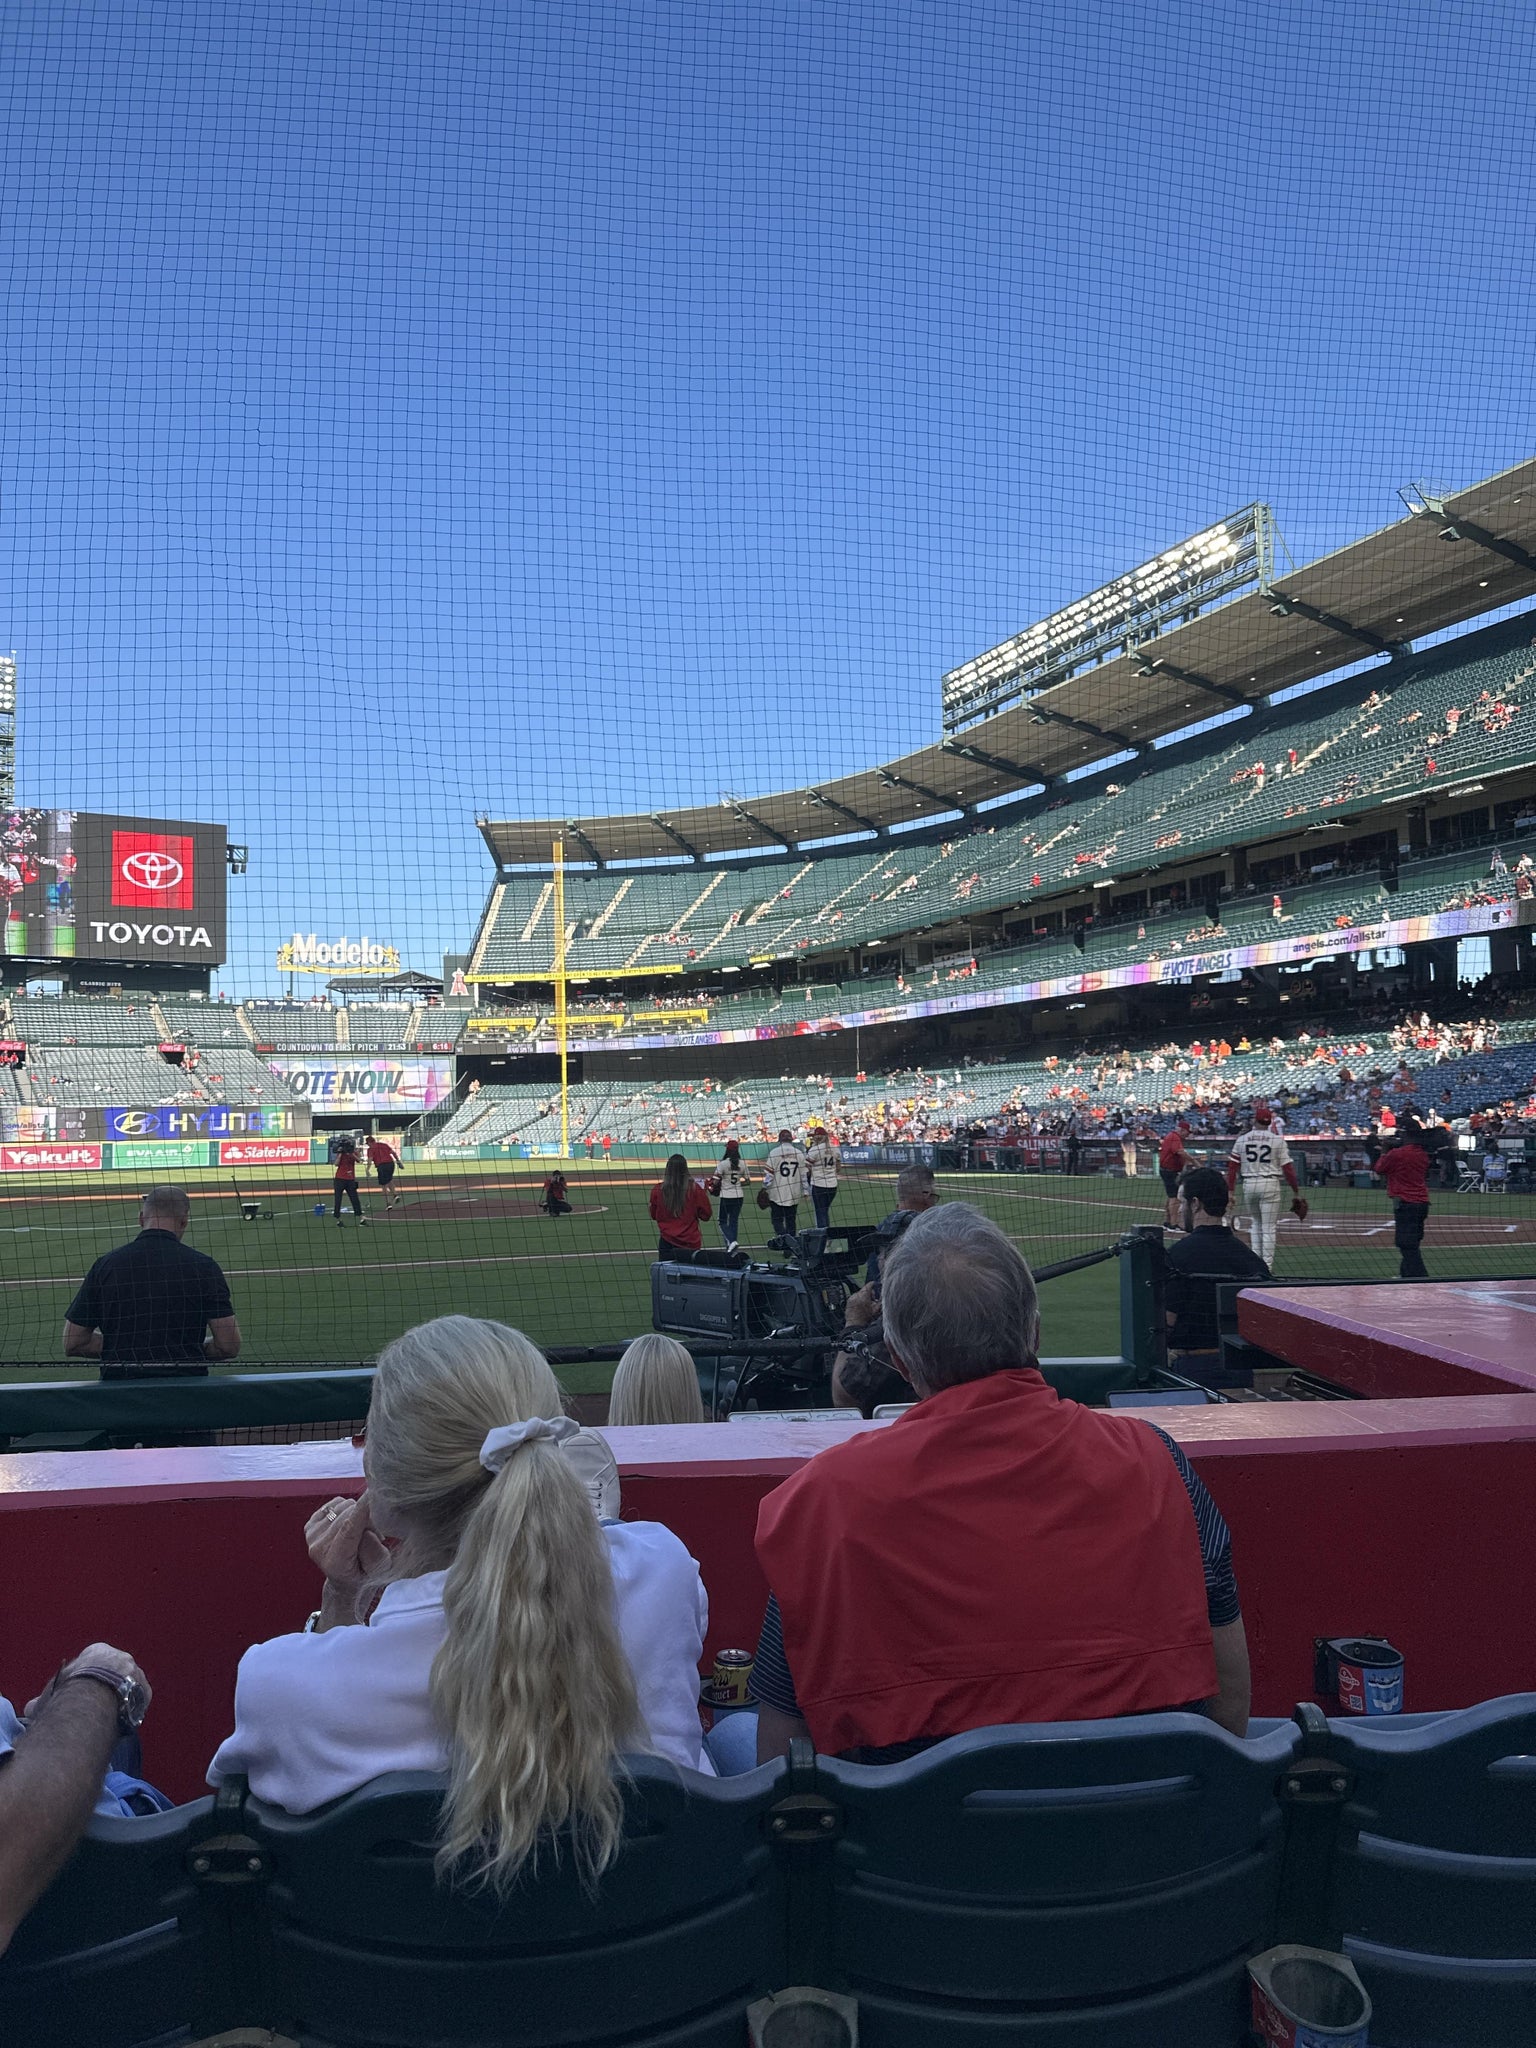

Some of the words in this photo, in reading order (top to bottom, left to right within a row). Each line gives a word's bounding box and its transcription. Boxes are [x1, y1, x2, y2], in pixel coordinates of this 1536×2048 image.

[90, 921, 212, 948] TOYOTA
[1292, 929, 1387, 953] angels.com/allstar
[292, 933, 384, 965] Modelo
[1162, 958, 1195, 978] #VOTE
[1196, 952, 1232, 974] ANGELS
[277, 1043, 322, 1051] COUNTDOWN
[324, 1043, 334, 1051] TO
[335, 1043, 356, 1051] FIRST
[357, 1043, 379, 1051] PITCH
[340, 1070, 403, 1095] NOW
[169, 1112, 292, 1132] HYUNDAI
[1017, 1139, 1057, 1150] SALINAS
[7, 1149, 95, 1165] Yakult
[824, 1156, 834, 1168] 14
[1245, 1144, 1272, 1163] 52
[780, 1161, 799, 1177] 67
[730, 1173, 738, 1185] 5
[681, 1296, 688, 1312] 7
